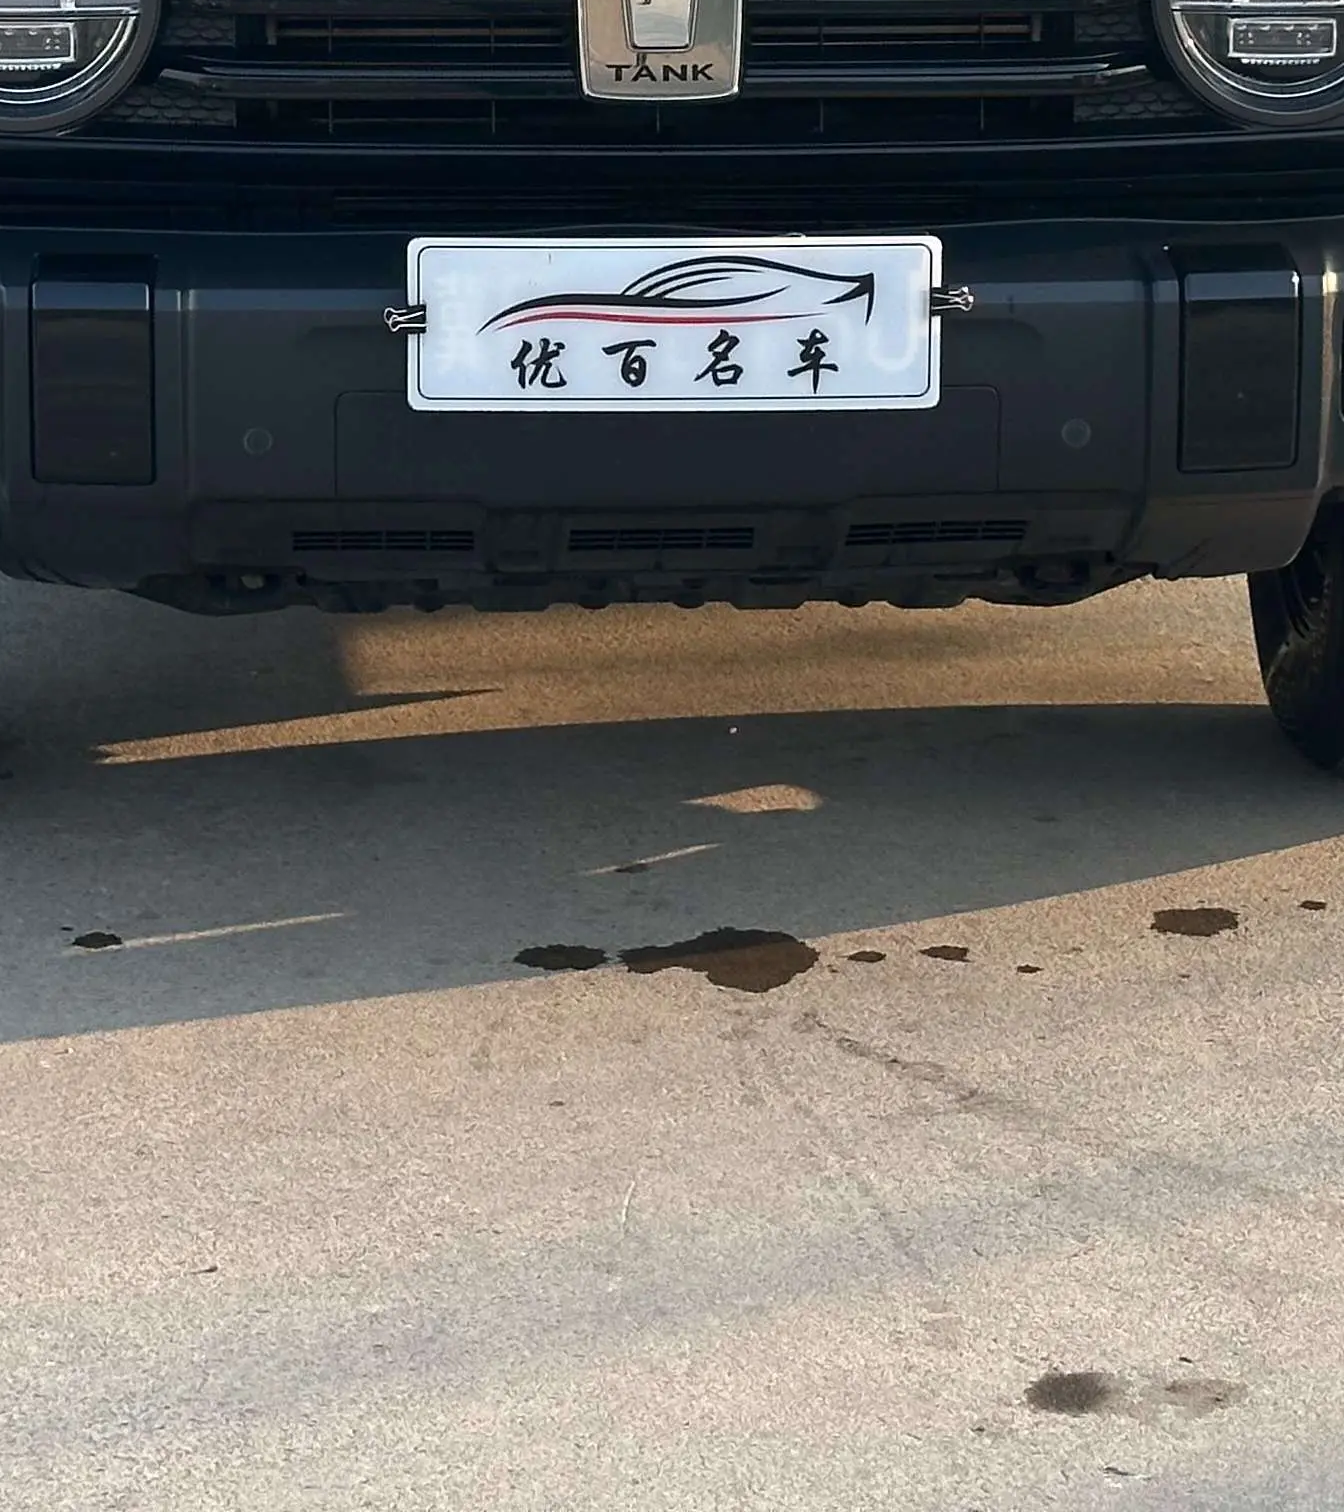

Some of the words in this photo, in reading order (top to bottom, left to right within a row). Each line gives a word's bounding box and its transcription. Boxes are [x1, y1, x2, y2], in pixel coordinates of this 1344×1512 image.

[605, 63, 714, 82] TANK
[510, 328, 840, 394] 优百名车
